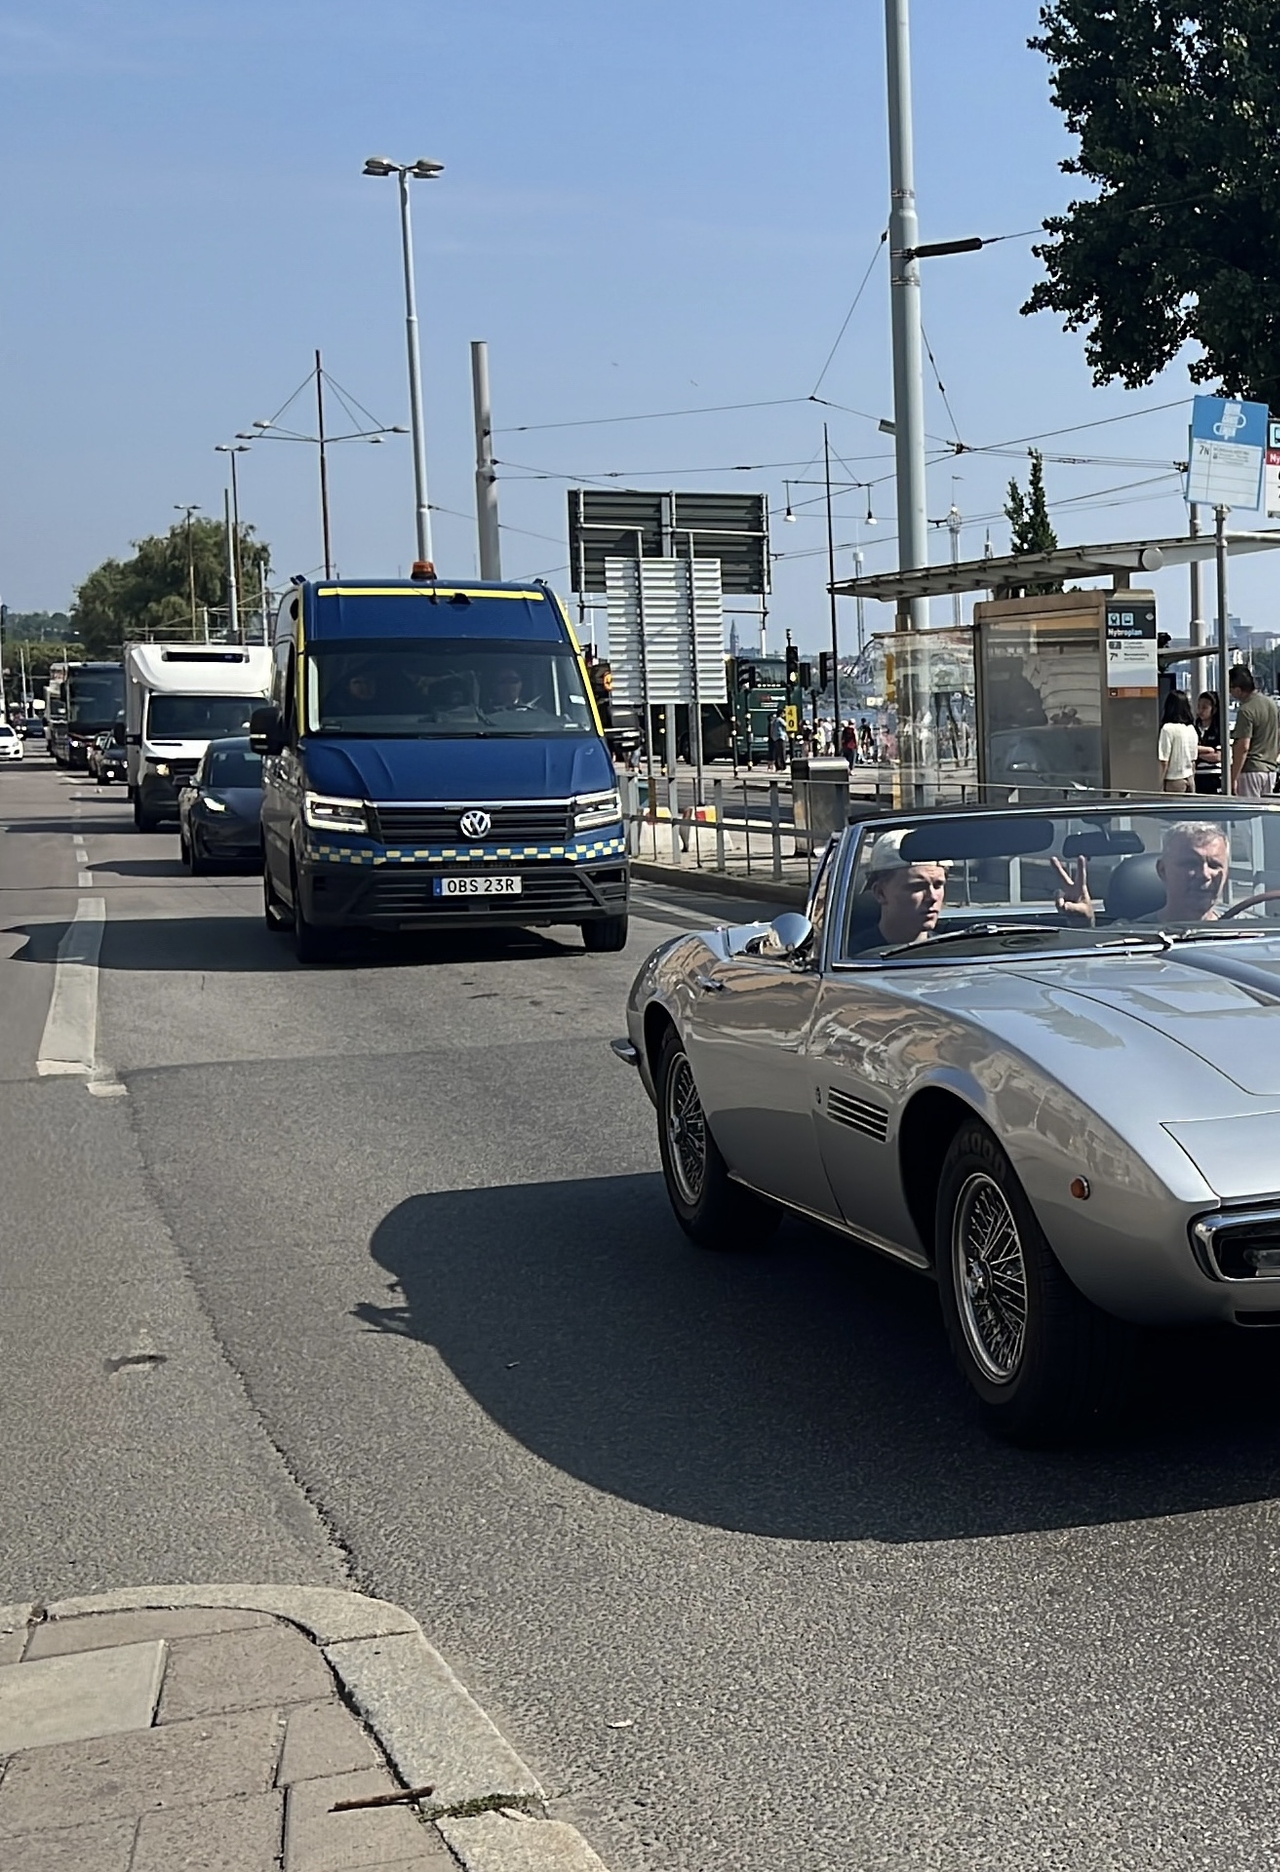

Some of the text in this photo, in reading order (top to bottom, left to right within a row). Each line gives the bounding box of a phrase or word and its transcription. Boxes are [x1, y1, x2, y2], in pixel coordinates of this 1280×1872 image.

[1107, 628, 1143, 637] Nybroplan
[447, 878, 514, 893] OBS 23R
